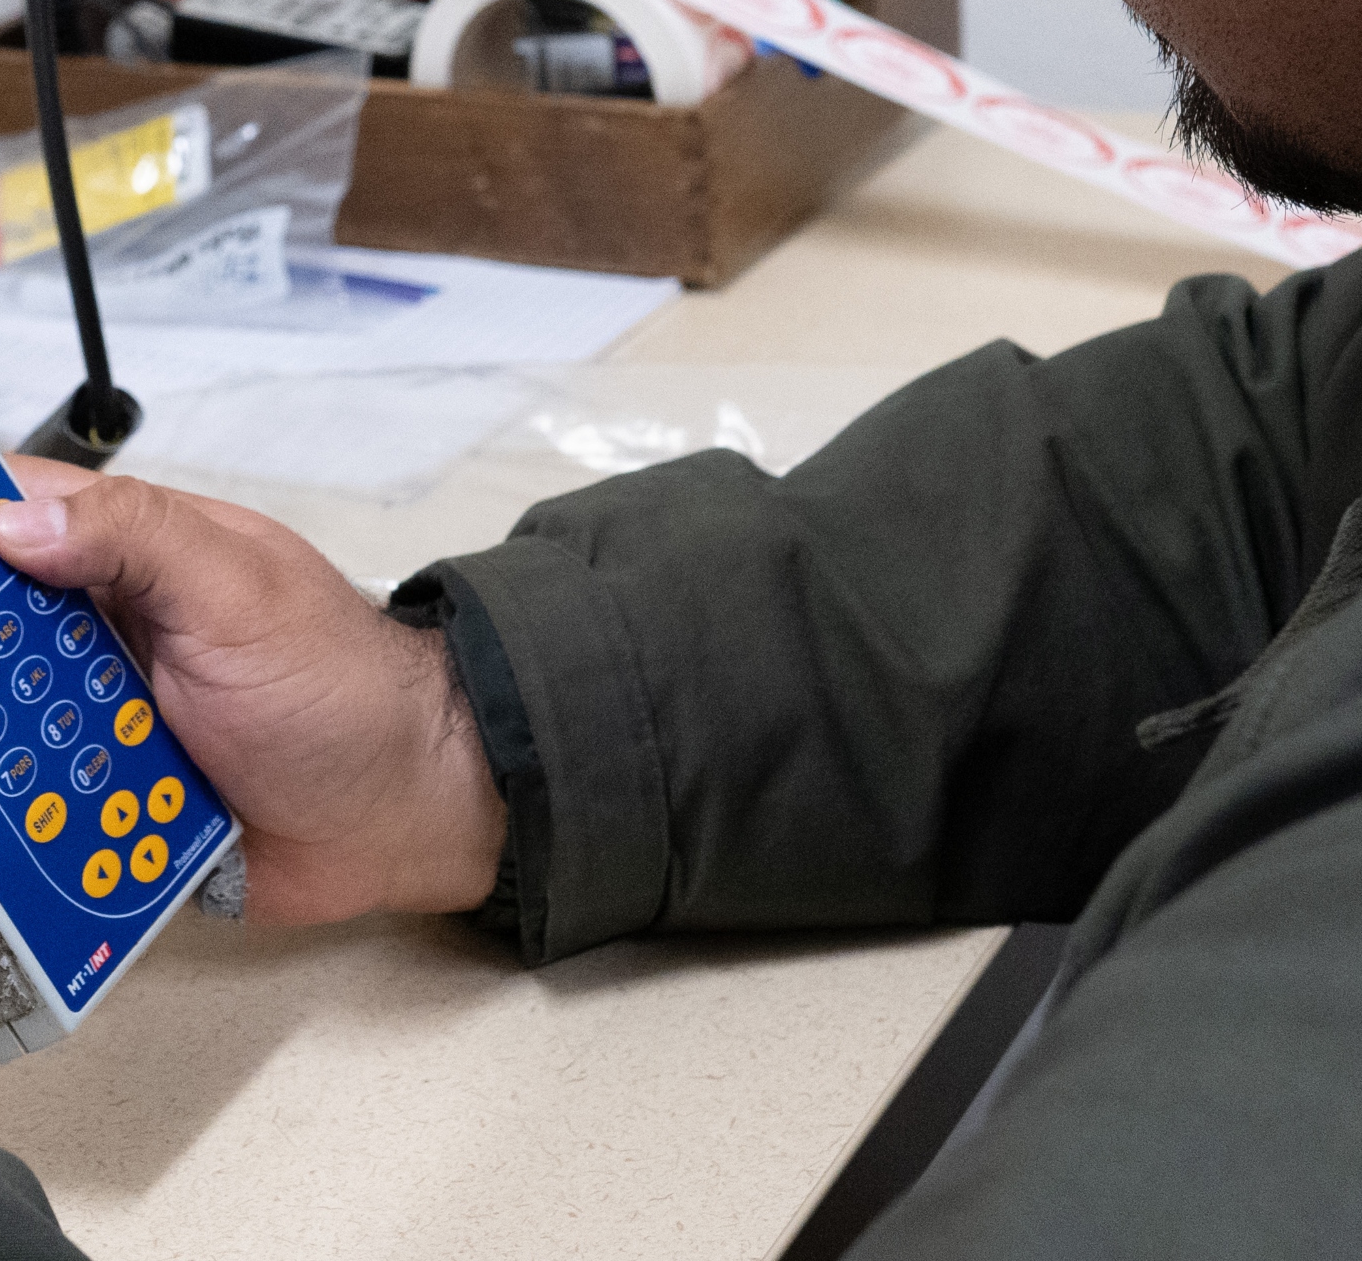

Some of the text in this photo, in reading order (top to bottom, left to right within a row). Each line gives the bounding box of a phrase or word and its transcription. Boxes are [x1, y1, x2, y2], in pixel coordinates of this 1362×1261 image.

[33, 590, 47, 607] 3
[63, 634, 76, 651] 6
[18, 678, 32, 697] 5
[91, 678, 105, 696] 9
[47, 709, 76, 741] 8 TUV
[120, 706, 149, 739] ENTER
[0, 755, 33, 790] 7 PQRS
[33, 801, 60, 833] SHIFT
